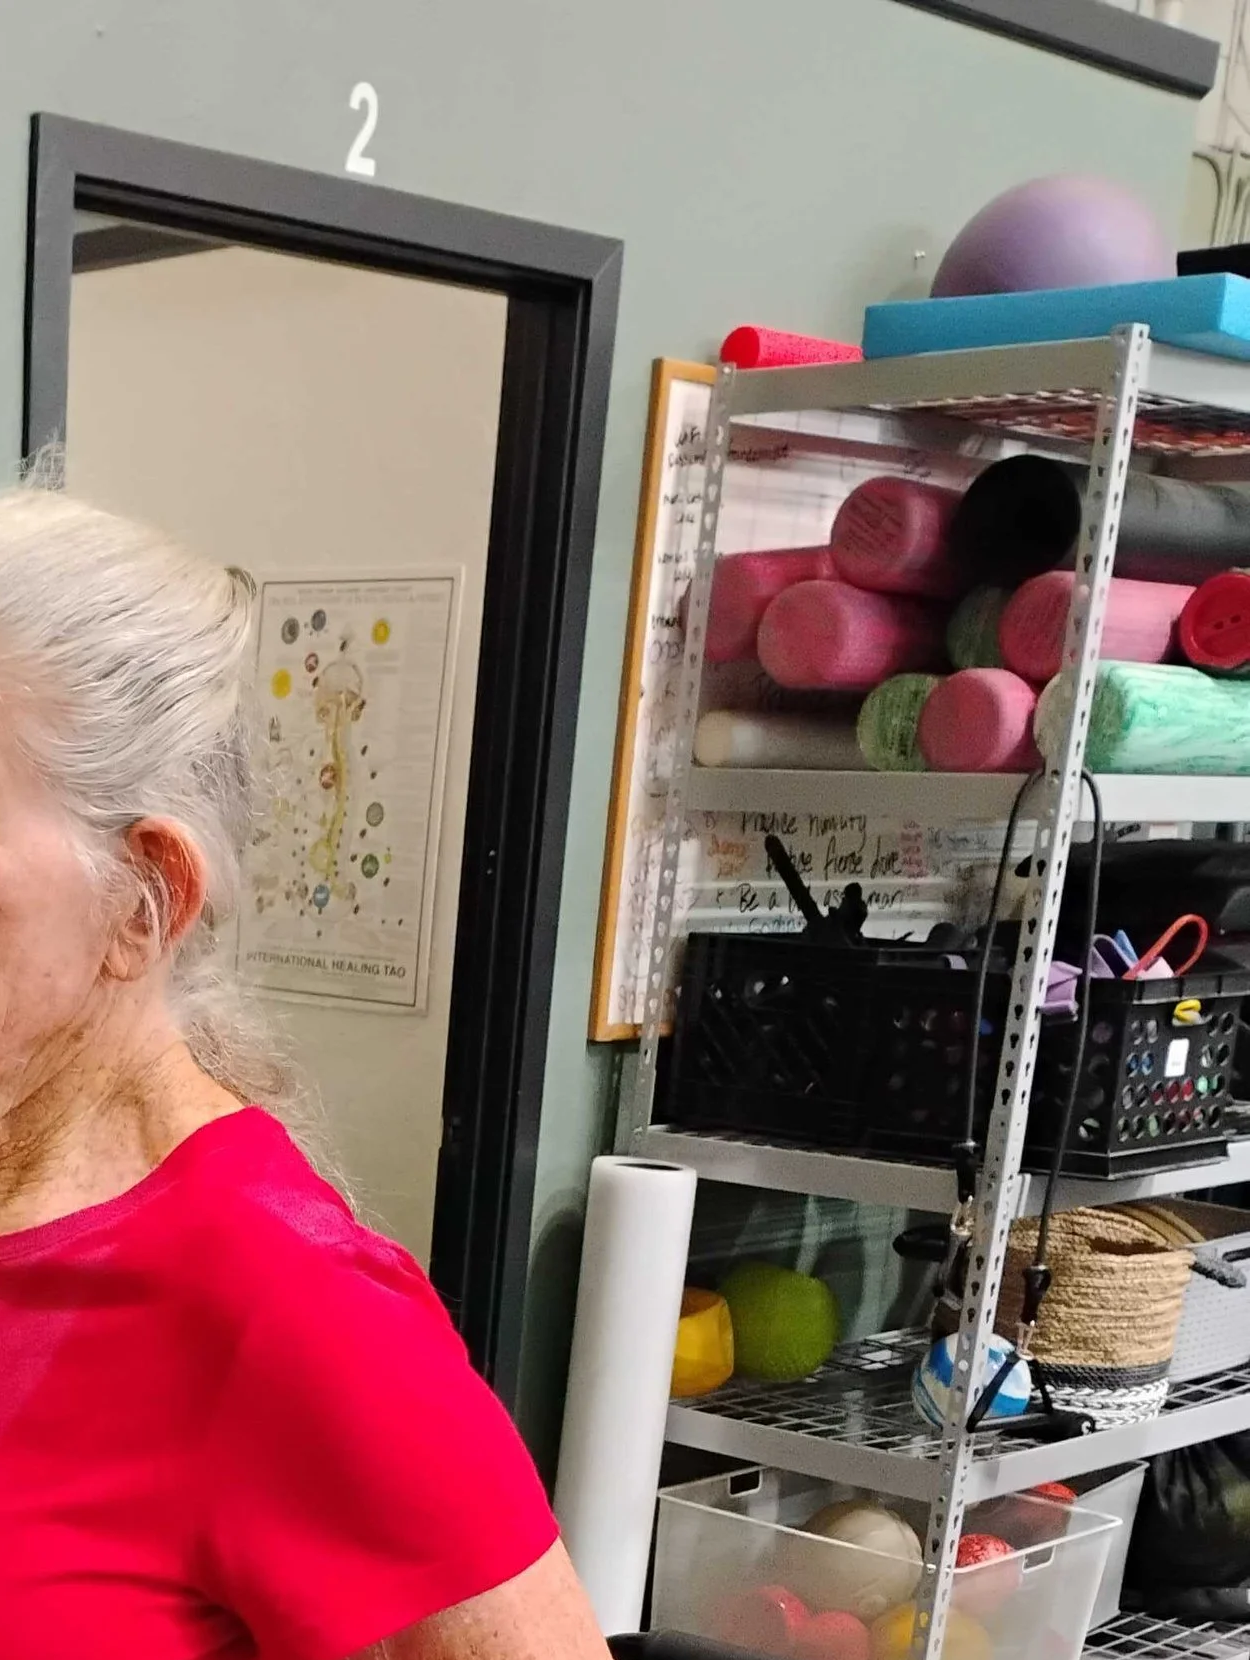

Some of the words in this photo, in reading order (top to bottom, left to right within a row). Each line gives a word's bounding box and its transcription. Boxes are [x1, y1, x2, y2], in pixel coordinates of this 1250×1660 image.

[345, 81, 379, 177] 2
[737, 883, 759, 913] Be
[246, 951, 328, 970] INTERNATIONAL
[331, 960, 380, 975] HEALING
[383, 964, 406, 979] TAO
